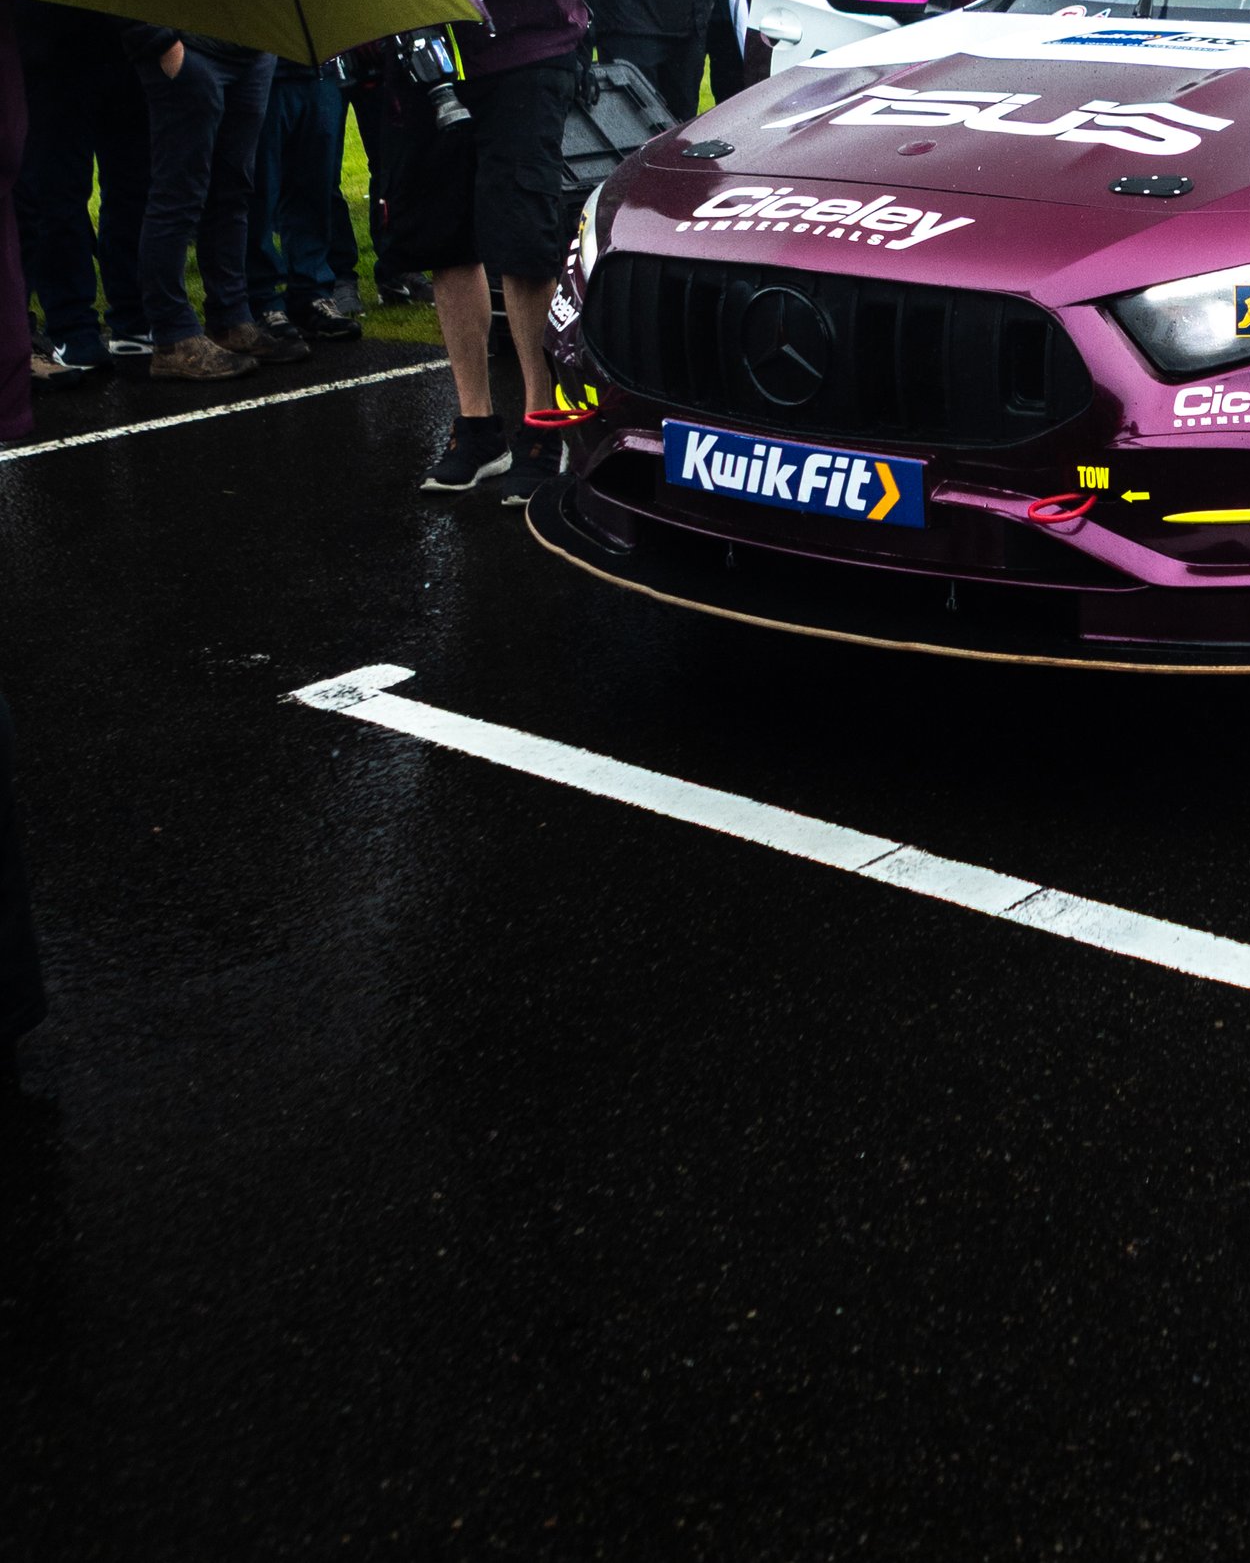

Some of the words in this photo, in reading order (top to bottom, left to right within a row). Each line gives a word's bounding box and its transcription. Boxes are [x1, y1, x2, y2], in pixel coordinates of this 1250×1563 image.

[760, 84, 1235, 156] ASUS
[675, 220, 885, 246] COMMERCIALS
[692, 186, 976, 250] Ciceley
[1077, 465, 1110, 490] TOW
